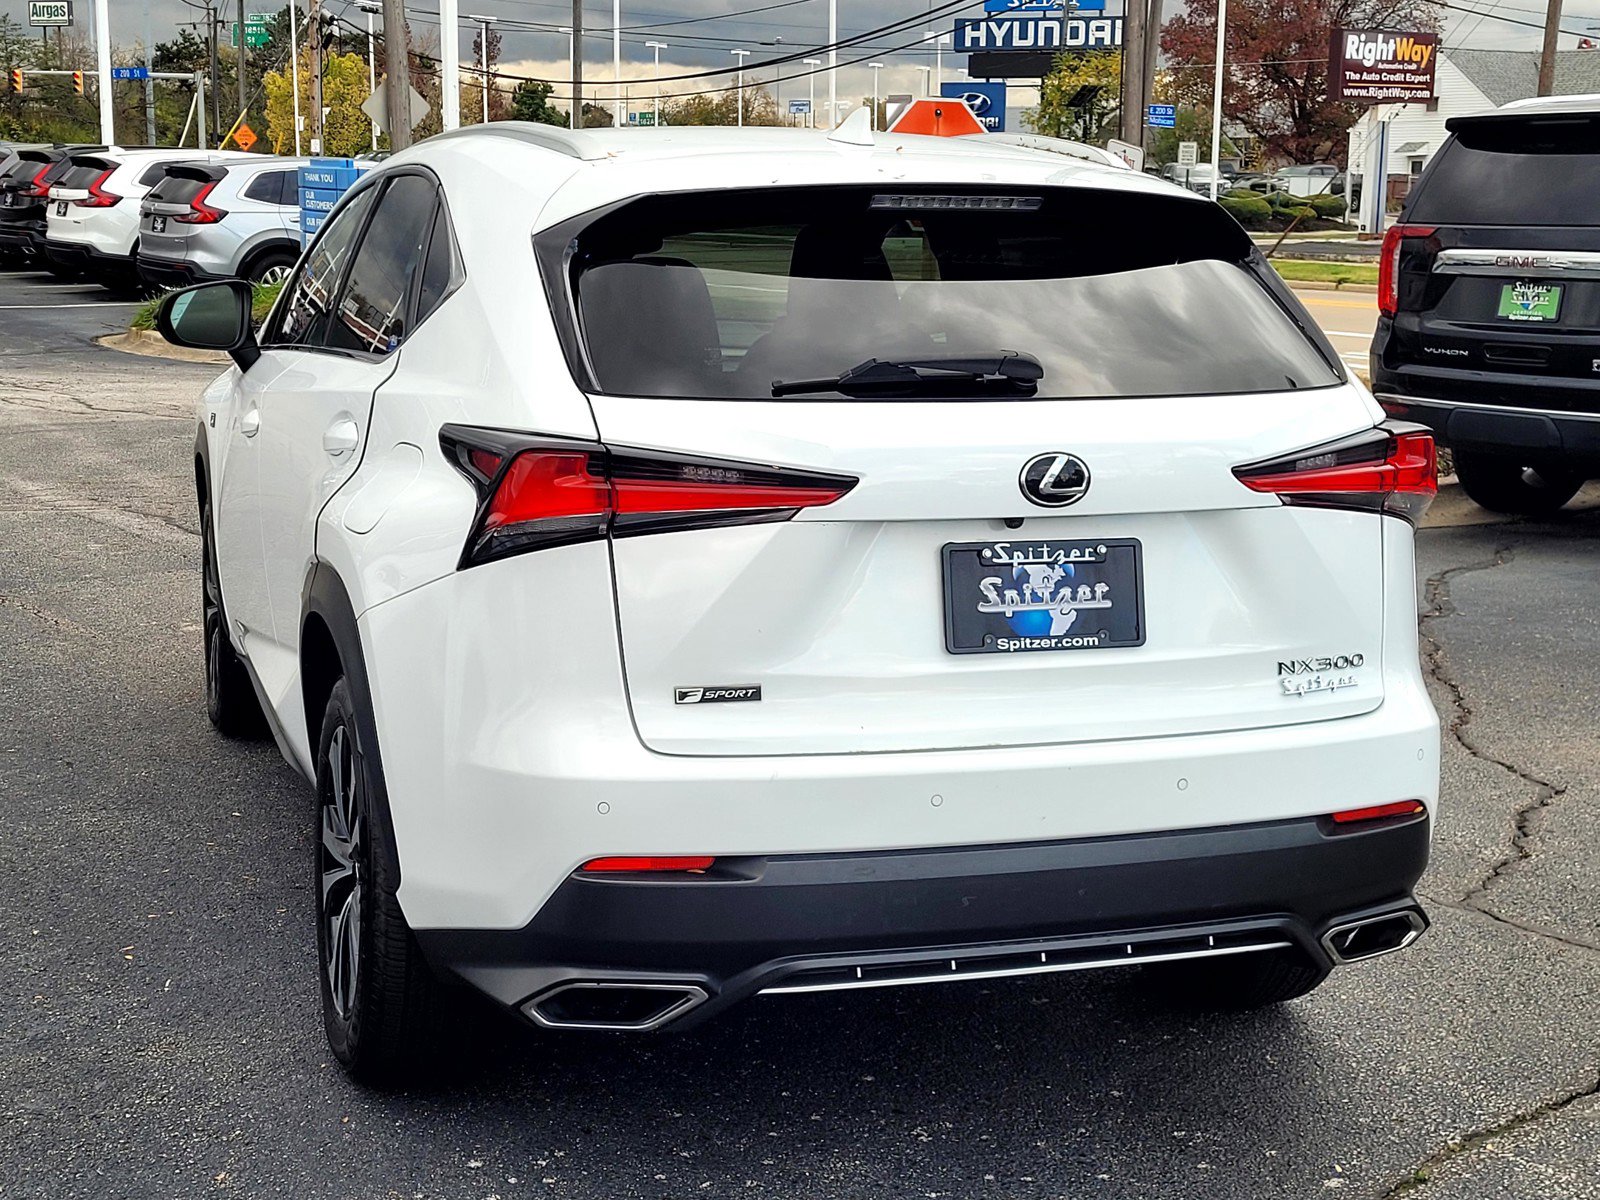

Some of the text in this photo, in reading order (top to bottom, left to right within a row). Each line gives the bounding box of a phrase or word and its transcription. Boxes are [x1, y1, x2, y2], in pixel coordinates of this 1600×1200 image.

[31, 3, 66, 18] Airgas
[965, 19, 1122, 47] HYUNDAI
[1345, 33, 1433, 68] RightWay
[112, 69, 140, 78] E 200 St
[1345, 71, 1431, 83] The Auto Credit Expert
[1343, 87, 1430, 99] www.RightWay.com
[1155, 107, 1166, 115] 200
[304, 172, 333, 183] THANK YOU
[305, 190, 315, 199] OUR
[306, 217, 316, 226] OUR
[1496, 256, 1550, 268] GMC
[1424, 347, 1469, 356] YUKON
[992, 543, 1096, 565] Spitzer
[977, 576, 1112, 617] Spitzer
[997, 635, 1099, 651] Spitzer.com
[1278, 653, 1364, 675] NX300
[703, 689, 757, 699] SPORT
